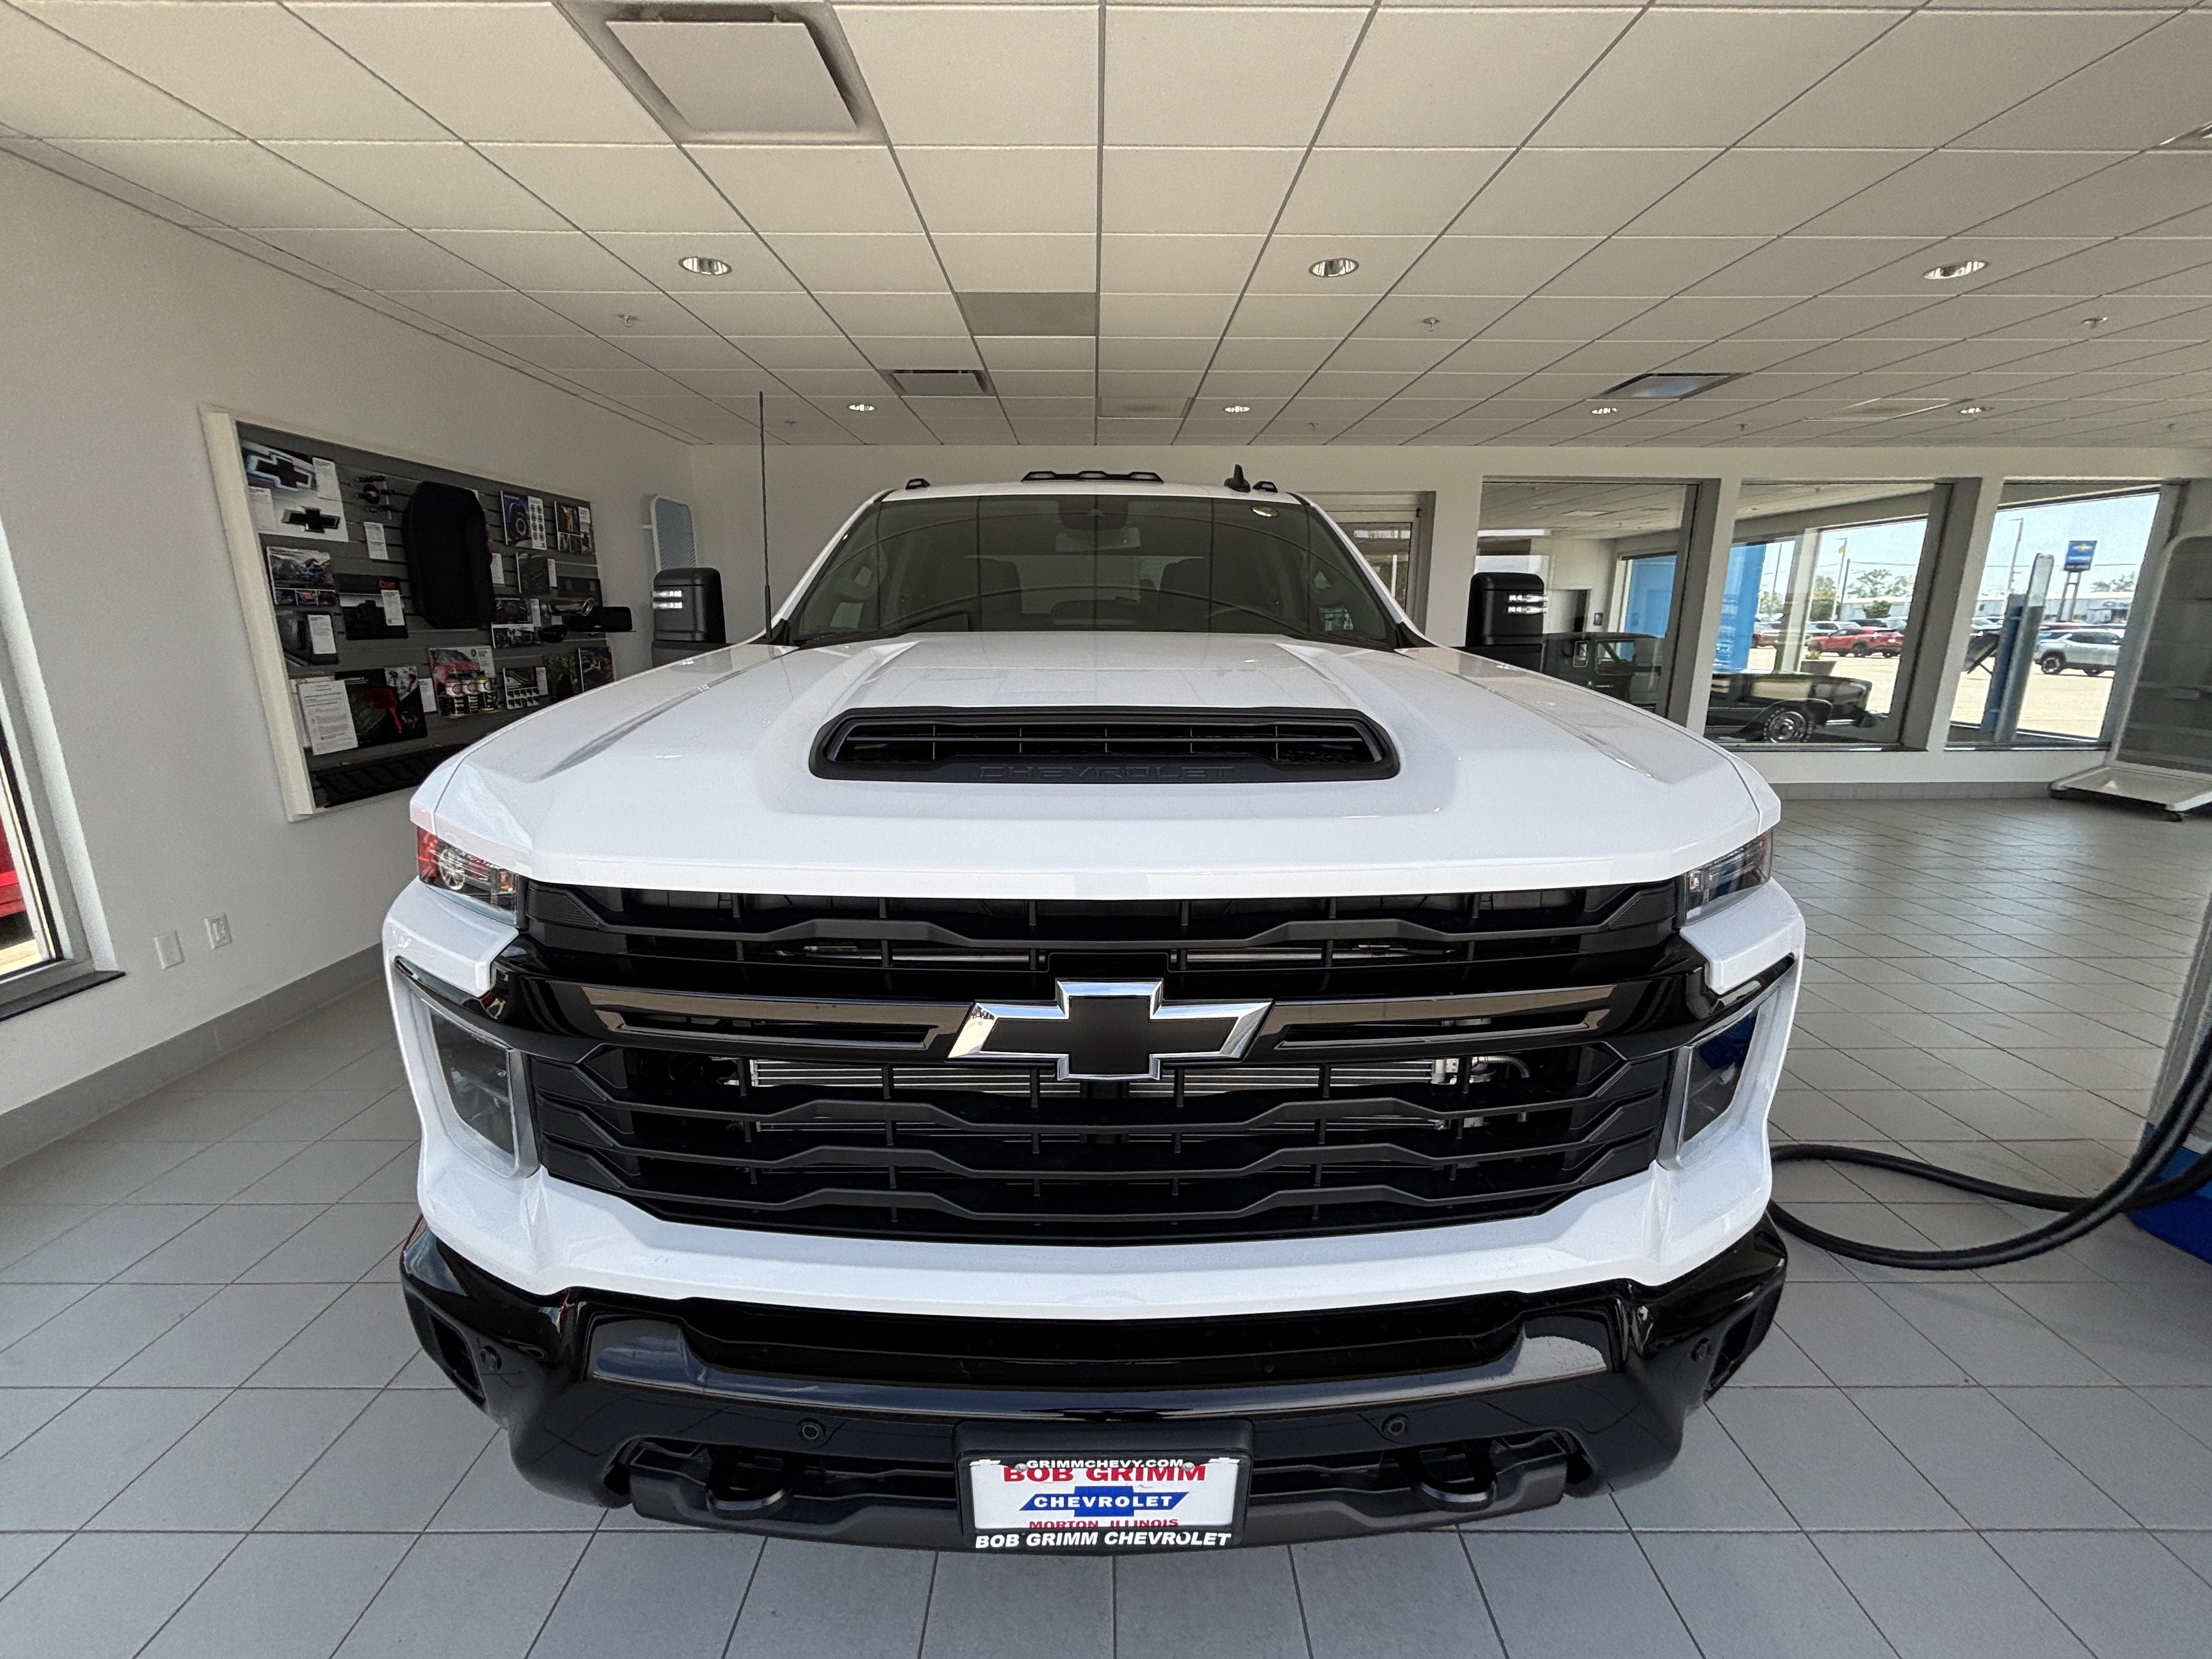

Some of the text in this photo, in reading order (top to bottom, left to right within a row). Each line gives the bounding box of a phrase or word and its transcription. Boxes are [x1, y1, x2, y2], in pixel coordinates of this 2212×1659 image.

[979, 766, 1233, 778] CHEVROLET
[1026, 1459, 1183, 1468] GRIMMCHEVY.COM
[1003, 1466, 1206, 1481] BOB GRIMM
[1034, 1496, 1172, 1508] CHEVROLET
[1110, 1519, 1178, 1527] ILLINOIS
[975, 1531, 1232, 1548] BOB GRIMM CHEVROLET
